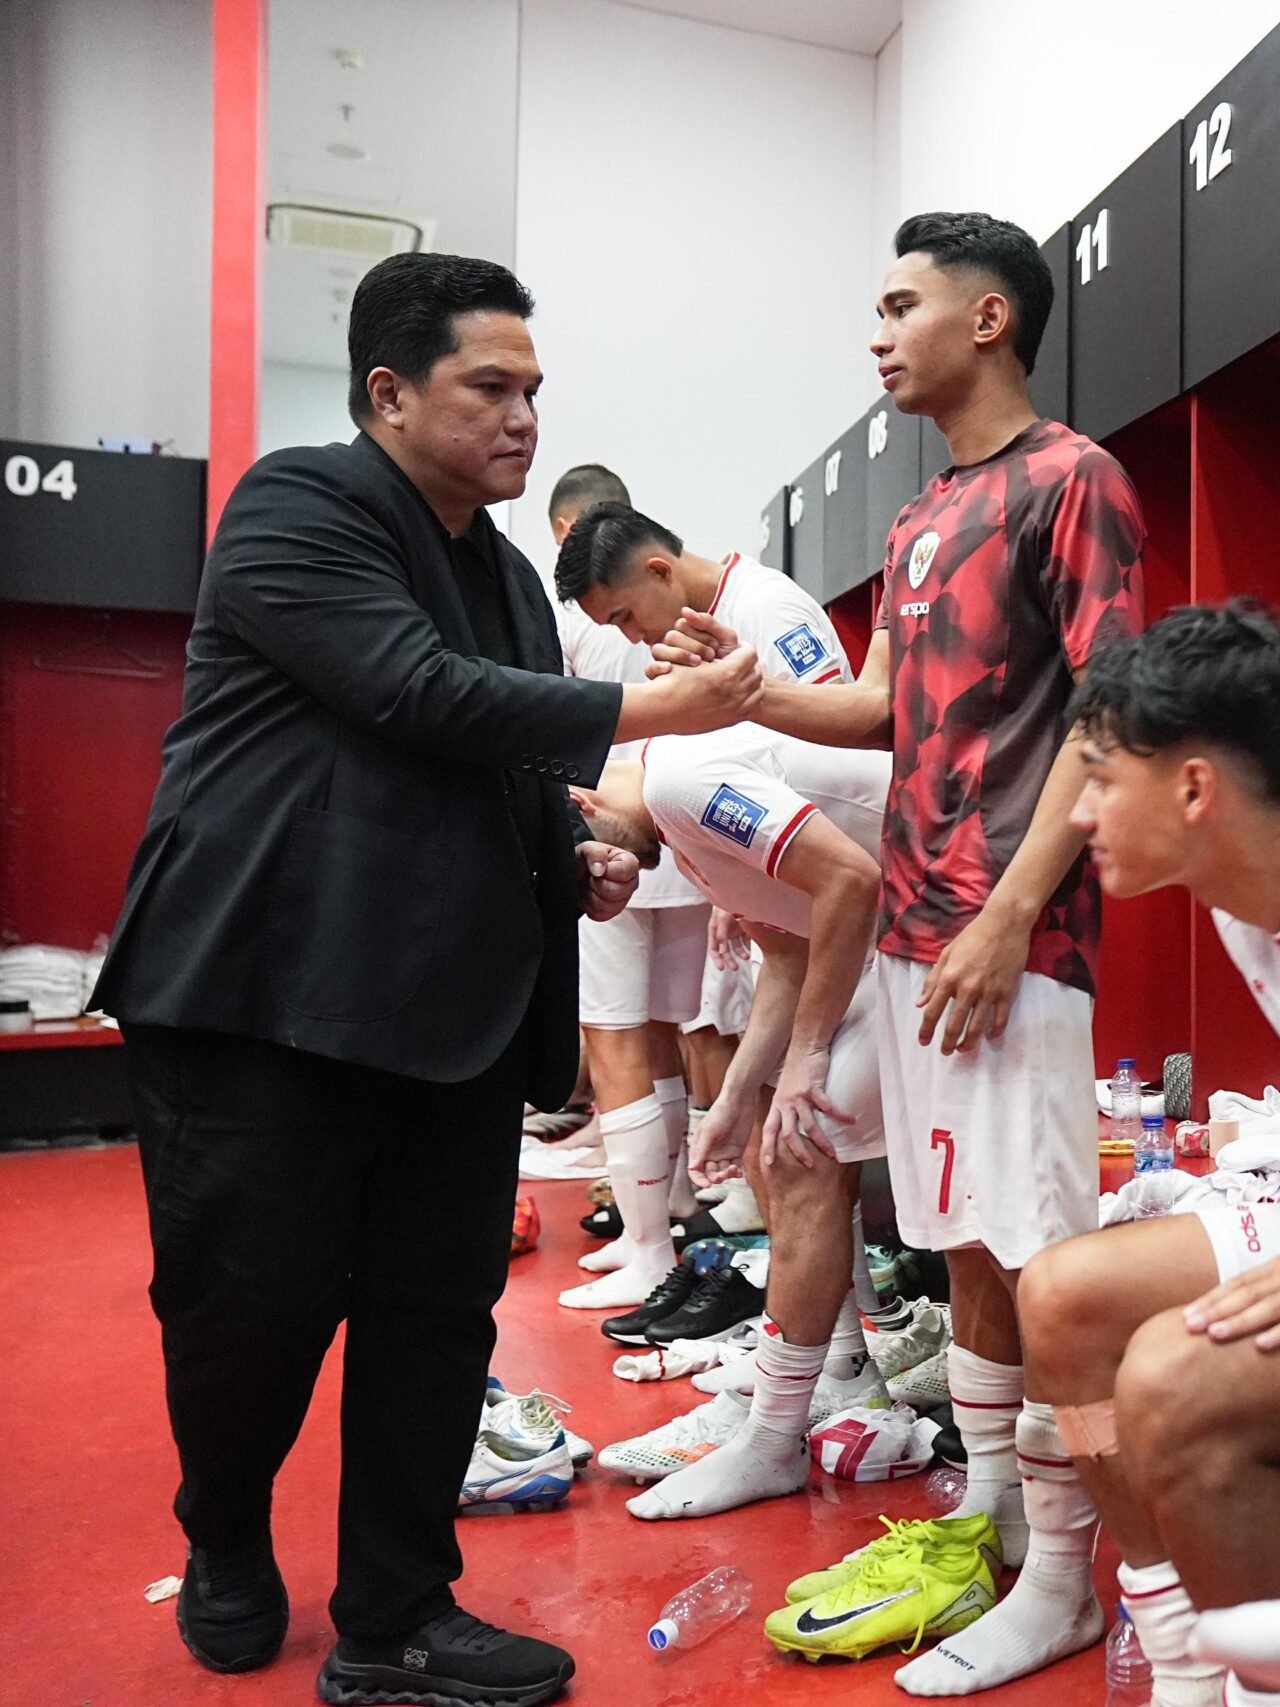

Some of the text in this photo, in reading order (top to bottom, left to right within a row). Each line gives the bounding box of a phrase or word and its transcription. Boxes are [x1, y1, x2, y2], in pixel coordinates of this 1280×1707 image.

[1188, 101, 1234, 192] 12
[1075, 208, 1110, 285] 11
[4, 455, 78, 501] 04
[825, 450, 842, 496] 07
[900, 601, 930, 618] erspo
[931, 1128, 954, 1214] 7
